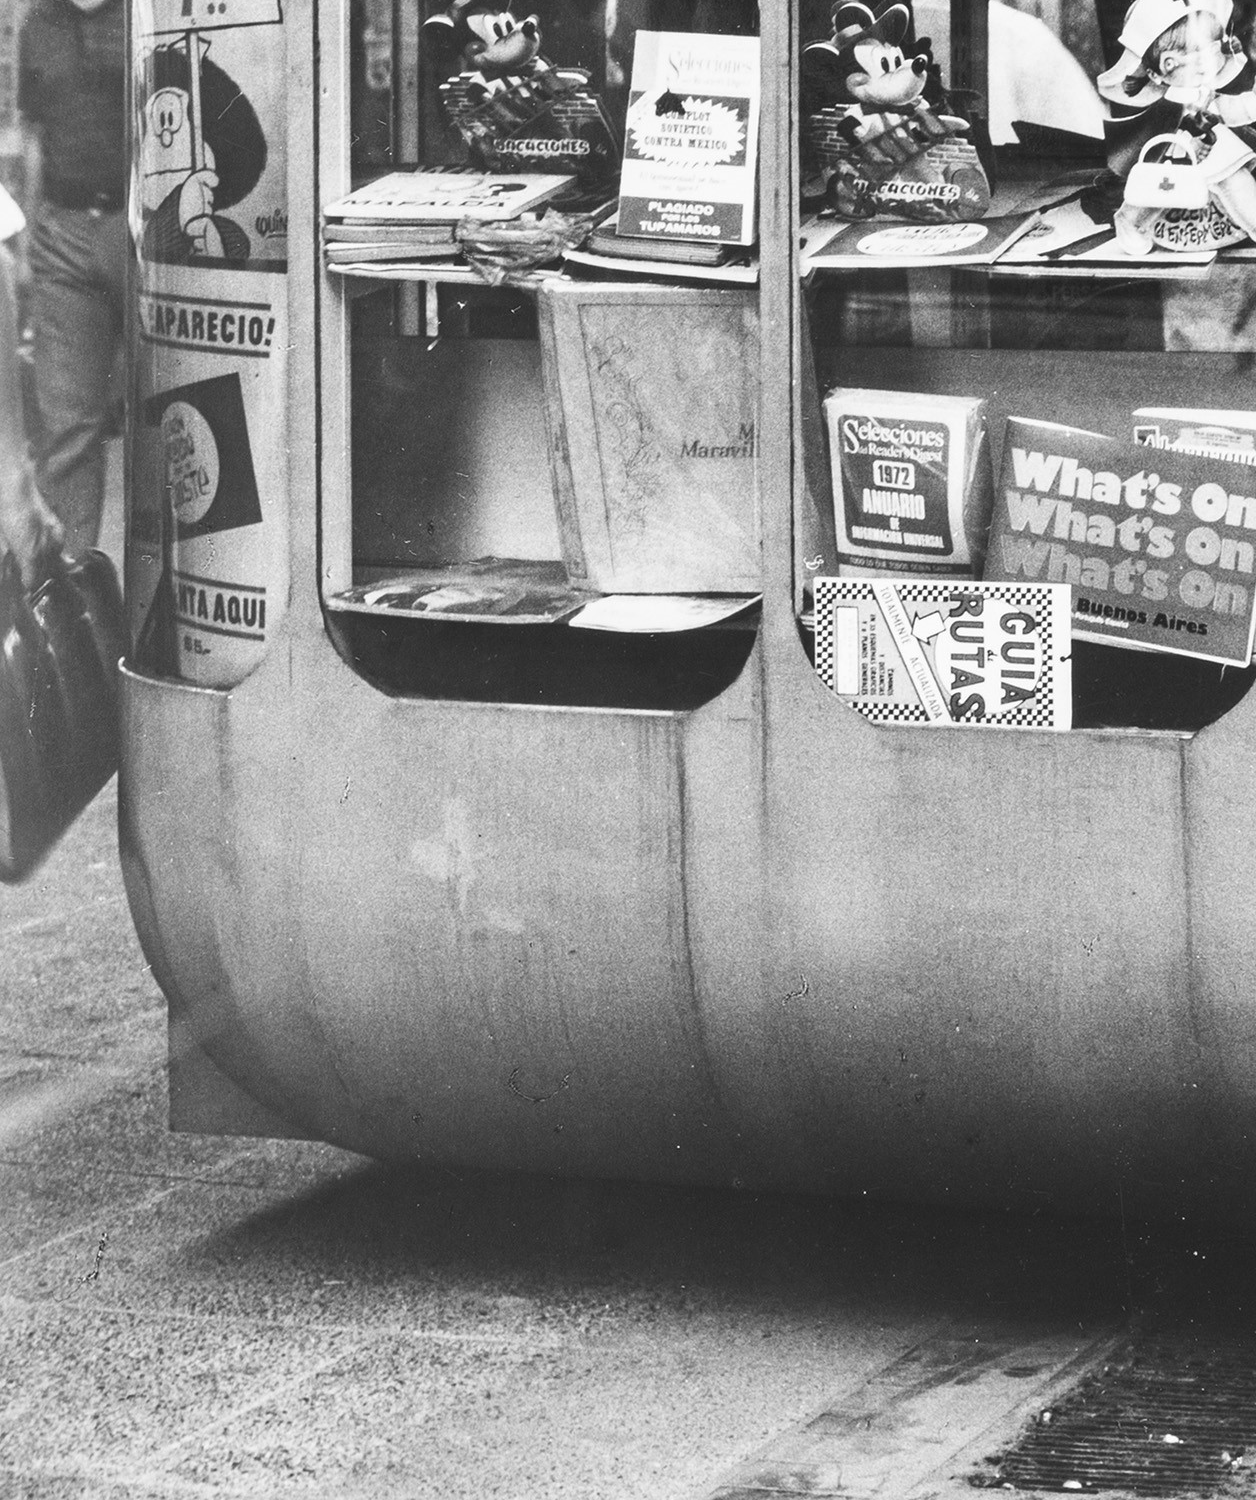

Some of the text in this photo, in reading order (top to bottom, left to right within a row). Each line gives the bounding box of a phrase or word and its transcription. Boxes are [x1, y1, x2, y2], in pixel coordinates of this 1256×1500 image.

[643, 135, 729, 151] CONTRA MEXICO
[648, 201, 715, 217] PLAGIADO
[681, 214, 701, 225] LOS
[639, 220, 721, 237] TUPAMAROS
[149, 303, 276, 348] APARECIO!
[843, 419, 945, 454] Selecciones
[877, 464, 910, 486] 1972
[1011, 447, 1183, 516] What's
[862, 487, 926, 521] ANUARIO
[1005, 490, 1255, 574] What's On
[1001, 534, 1249, 616] What's On
[212, 593, 266, 630] AQUI
[1076, 597, 1148, 625] Buenos
[1152, 612, 1209, 636] Aires
[879, 586, 909, 645] TOTALMENTE
[909, 655, 943, 720] ACTUALIZADA
[949, 592, 986, 719] RUTAS
[999, 612, 1036, 705] GUIA
